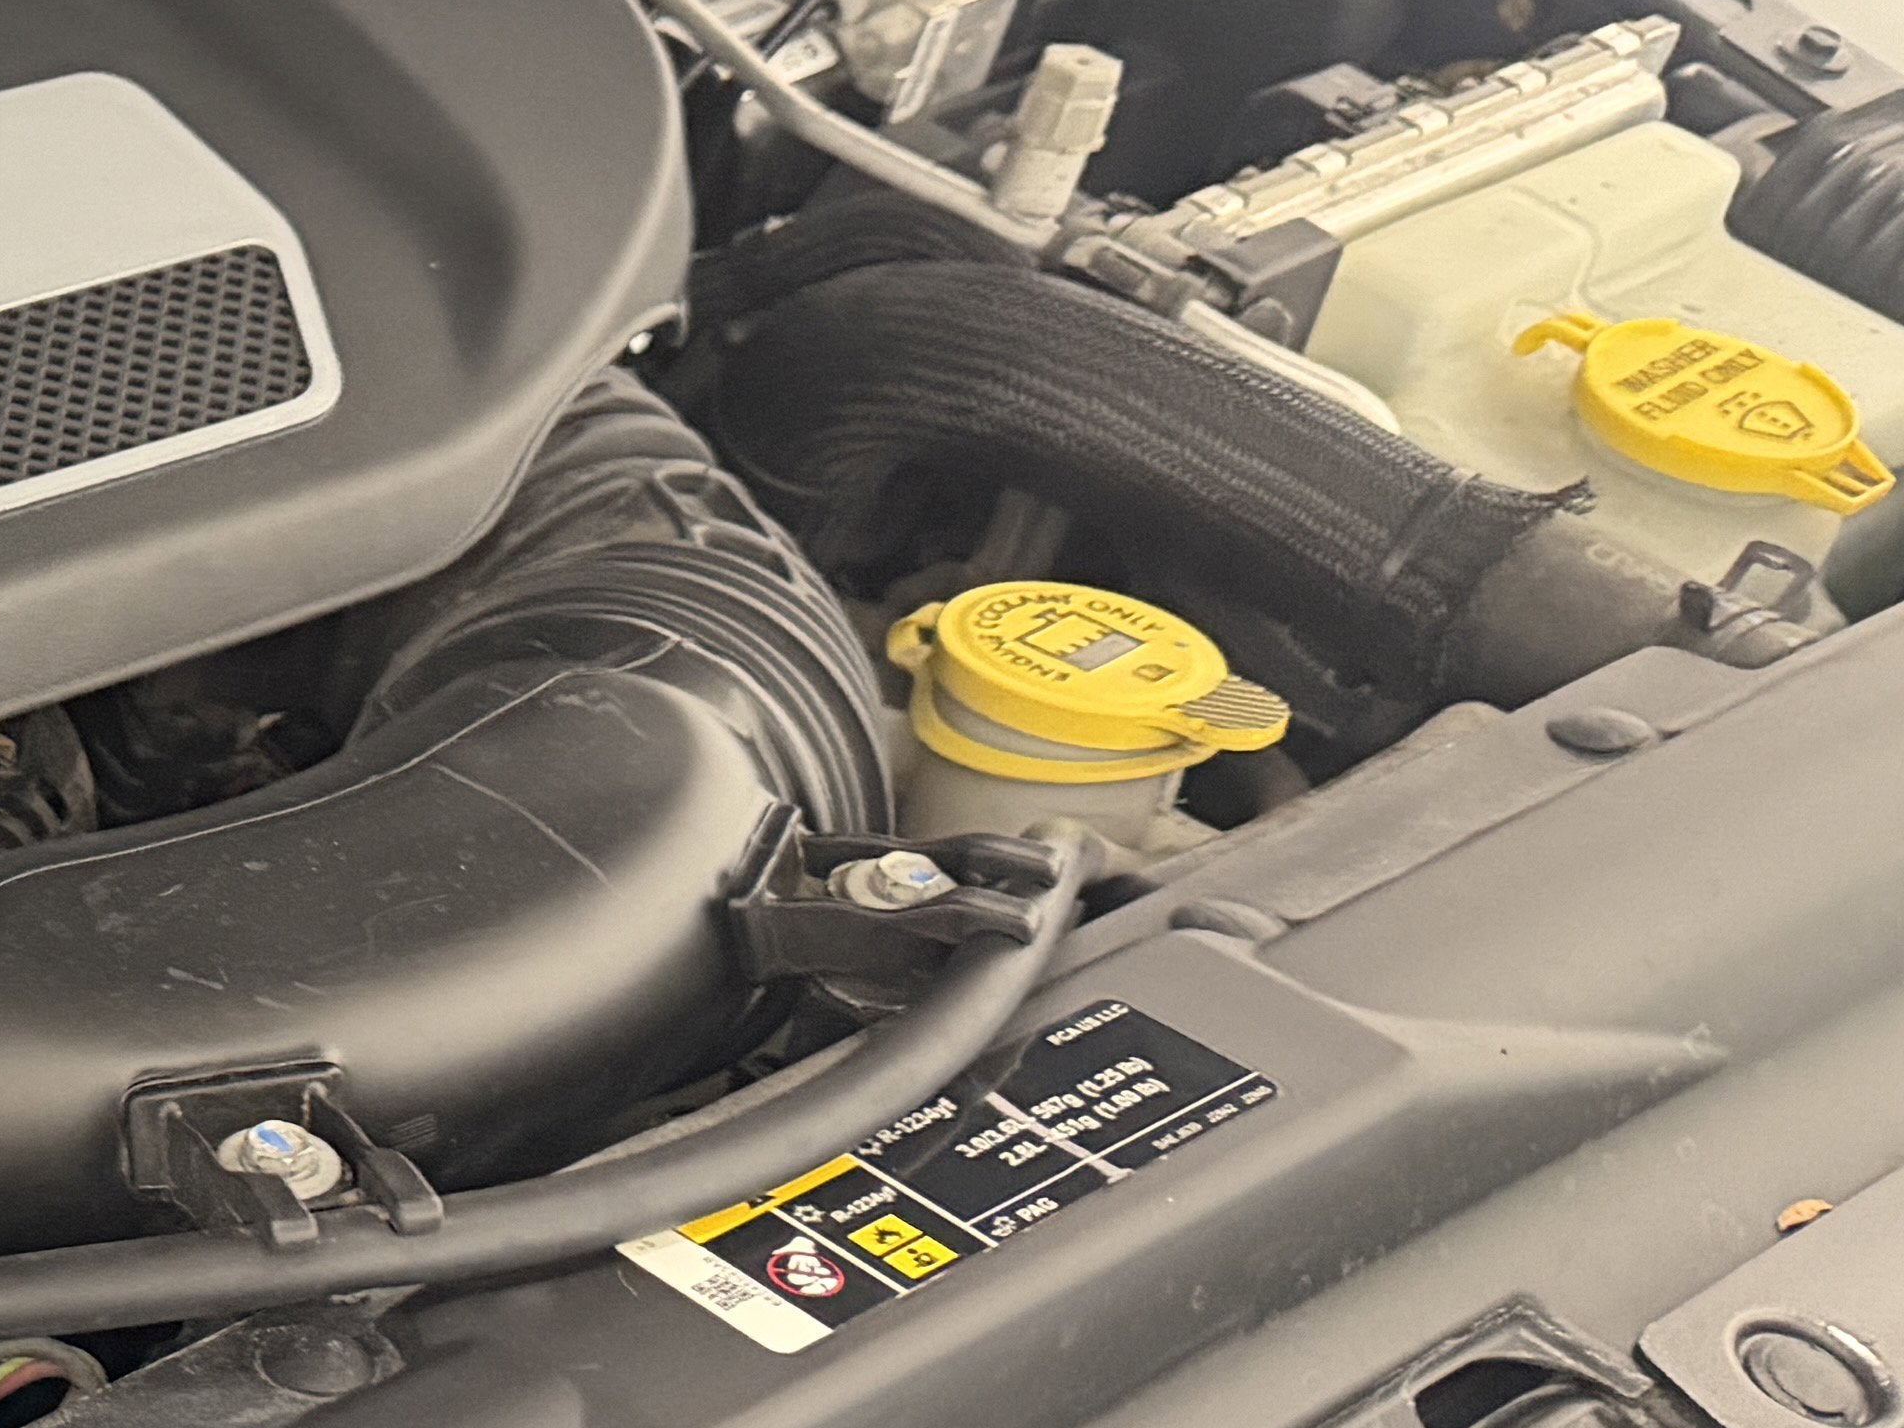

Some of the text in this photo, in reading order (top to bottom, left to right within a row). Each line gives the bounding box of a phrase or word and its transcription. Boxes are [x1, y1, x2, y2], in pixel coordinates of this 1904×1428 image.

[1616, 338, 1721, 395] WASHER
[1632, 348, 1766, 422] FLUID ONLY
[1085, 600, 1166, 632] ONLY
[1046, 1003, 1130, 1046] FCA US LLC
[1030, 1093, 1086, 1120] 567g
[1076, 1064, 1125, 1098] (1.25
[1114, 1056, 1155, 1080] lb)
[875, 1096, 959, 1147] R-1234yf
[1015, 1196, 1059, 1223] PAG
